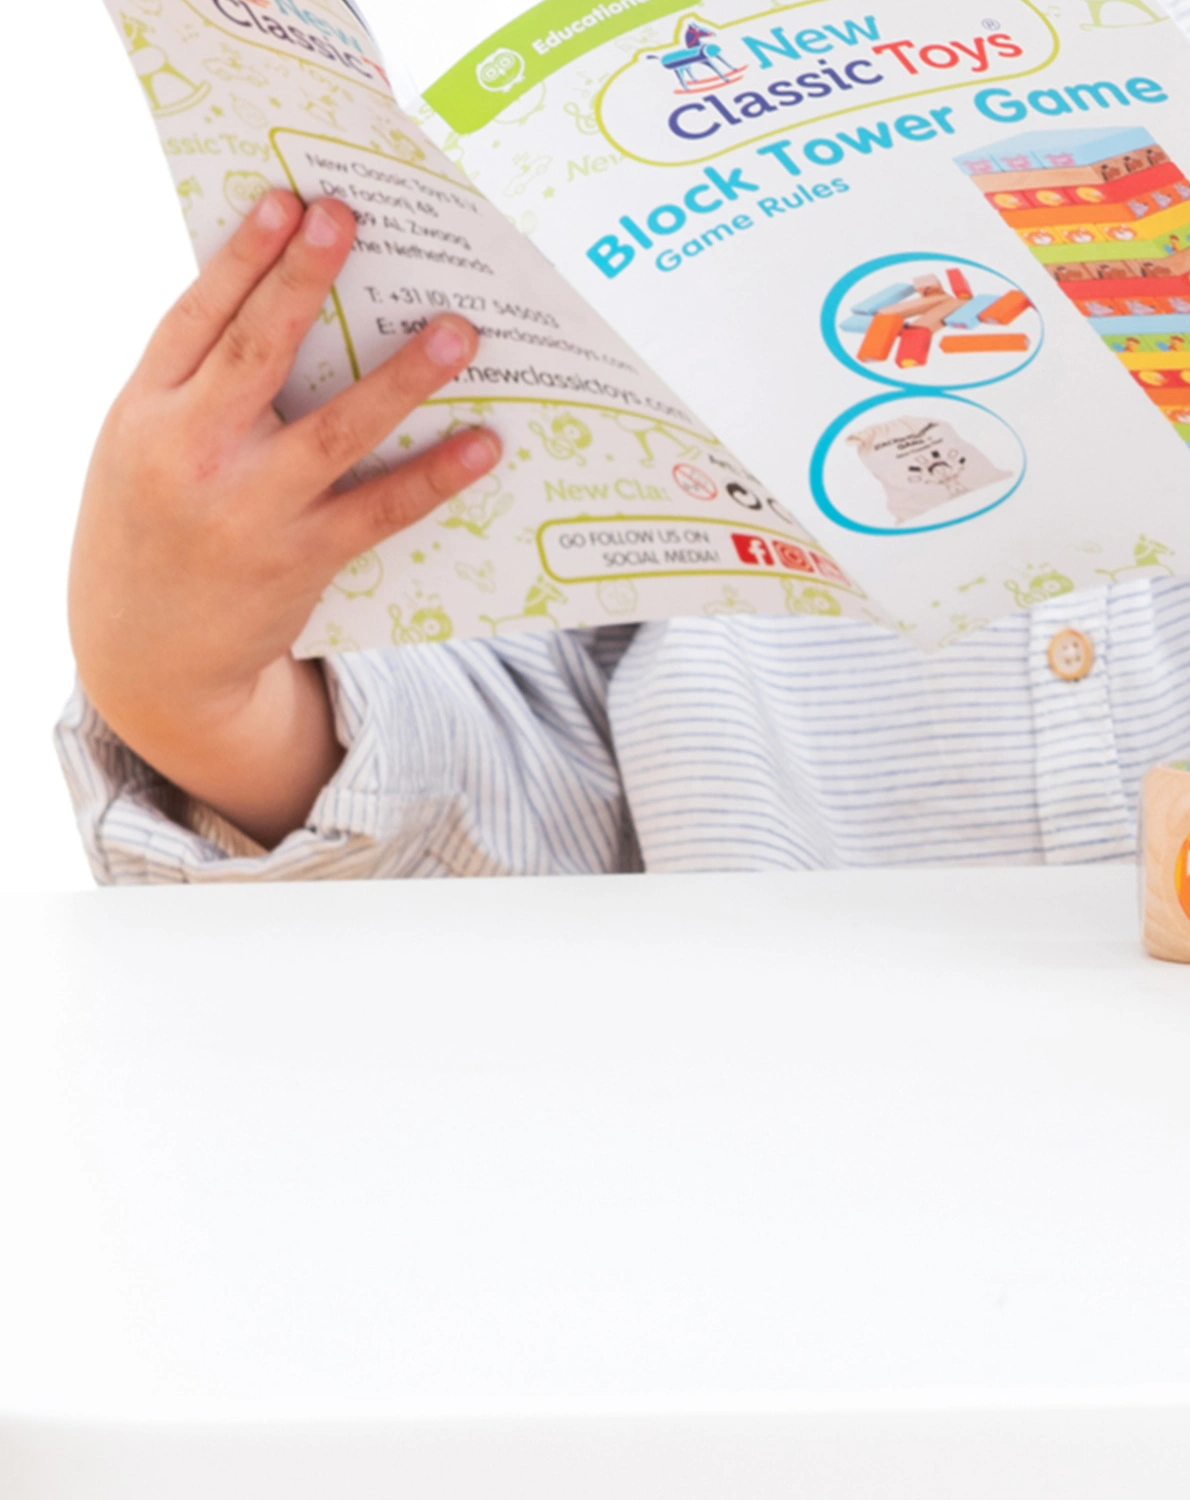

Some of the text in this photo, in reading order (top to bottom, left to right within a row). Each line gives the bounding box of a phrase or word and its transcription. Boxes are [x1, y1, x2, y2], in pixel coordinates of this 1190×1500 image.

[741, 15, 881, 69] New
[668, 33, 1023, 140] Classic Toys
[162, 133, 272, 163] ssic Toy
[319, 179, 347, 198] De
[586, 76, 1168, 279] Block Tower Game
[655, 175, 850, 272] Game Rules
[384, 241, 495, 276] Netherlands
[390, 287, 423, 305] +31
[452, 292, 487, 311] 227
[543, 477, 609, 503] New
[558, 530, 710, 549] GO FOLLOW US ON
[602, 549, 721, 567] SOCIAL MEDIA!
